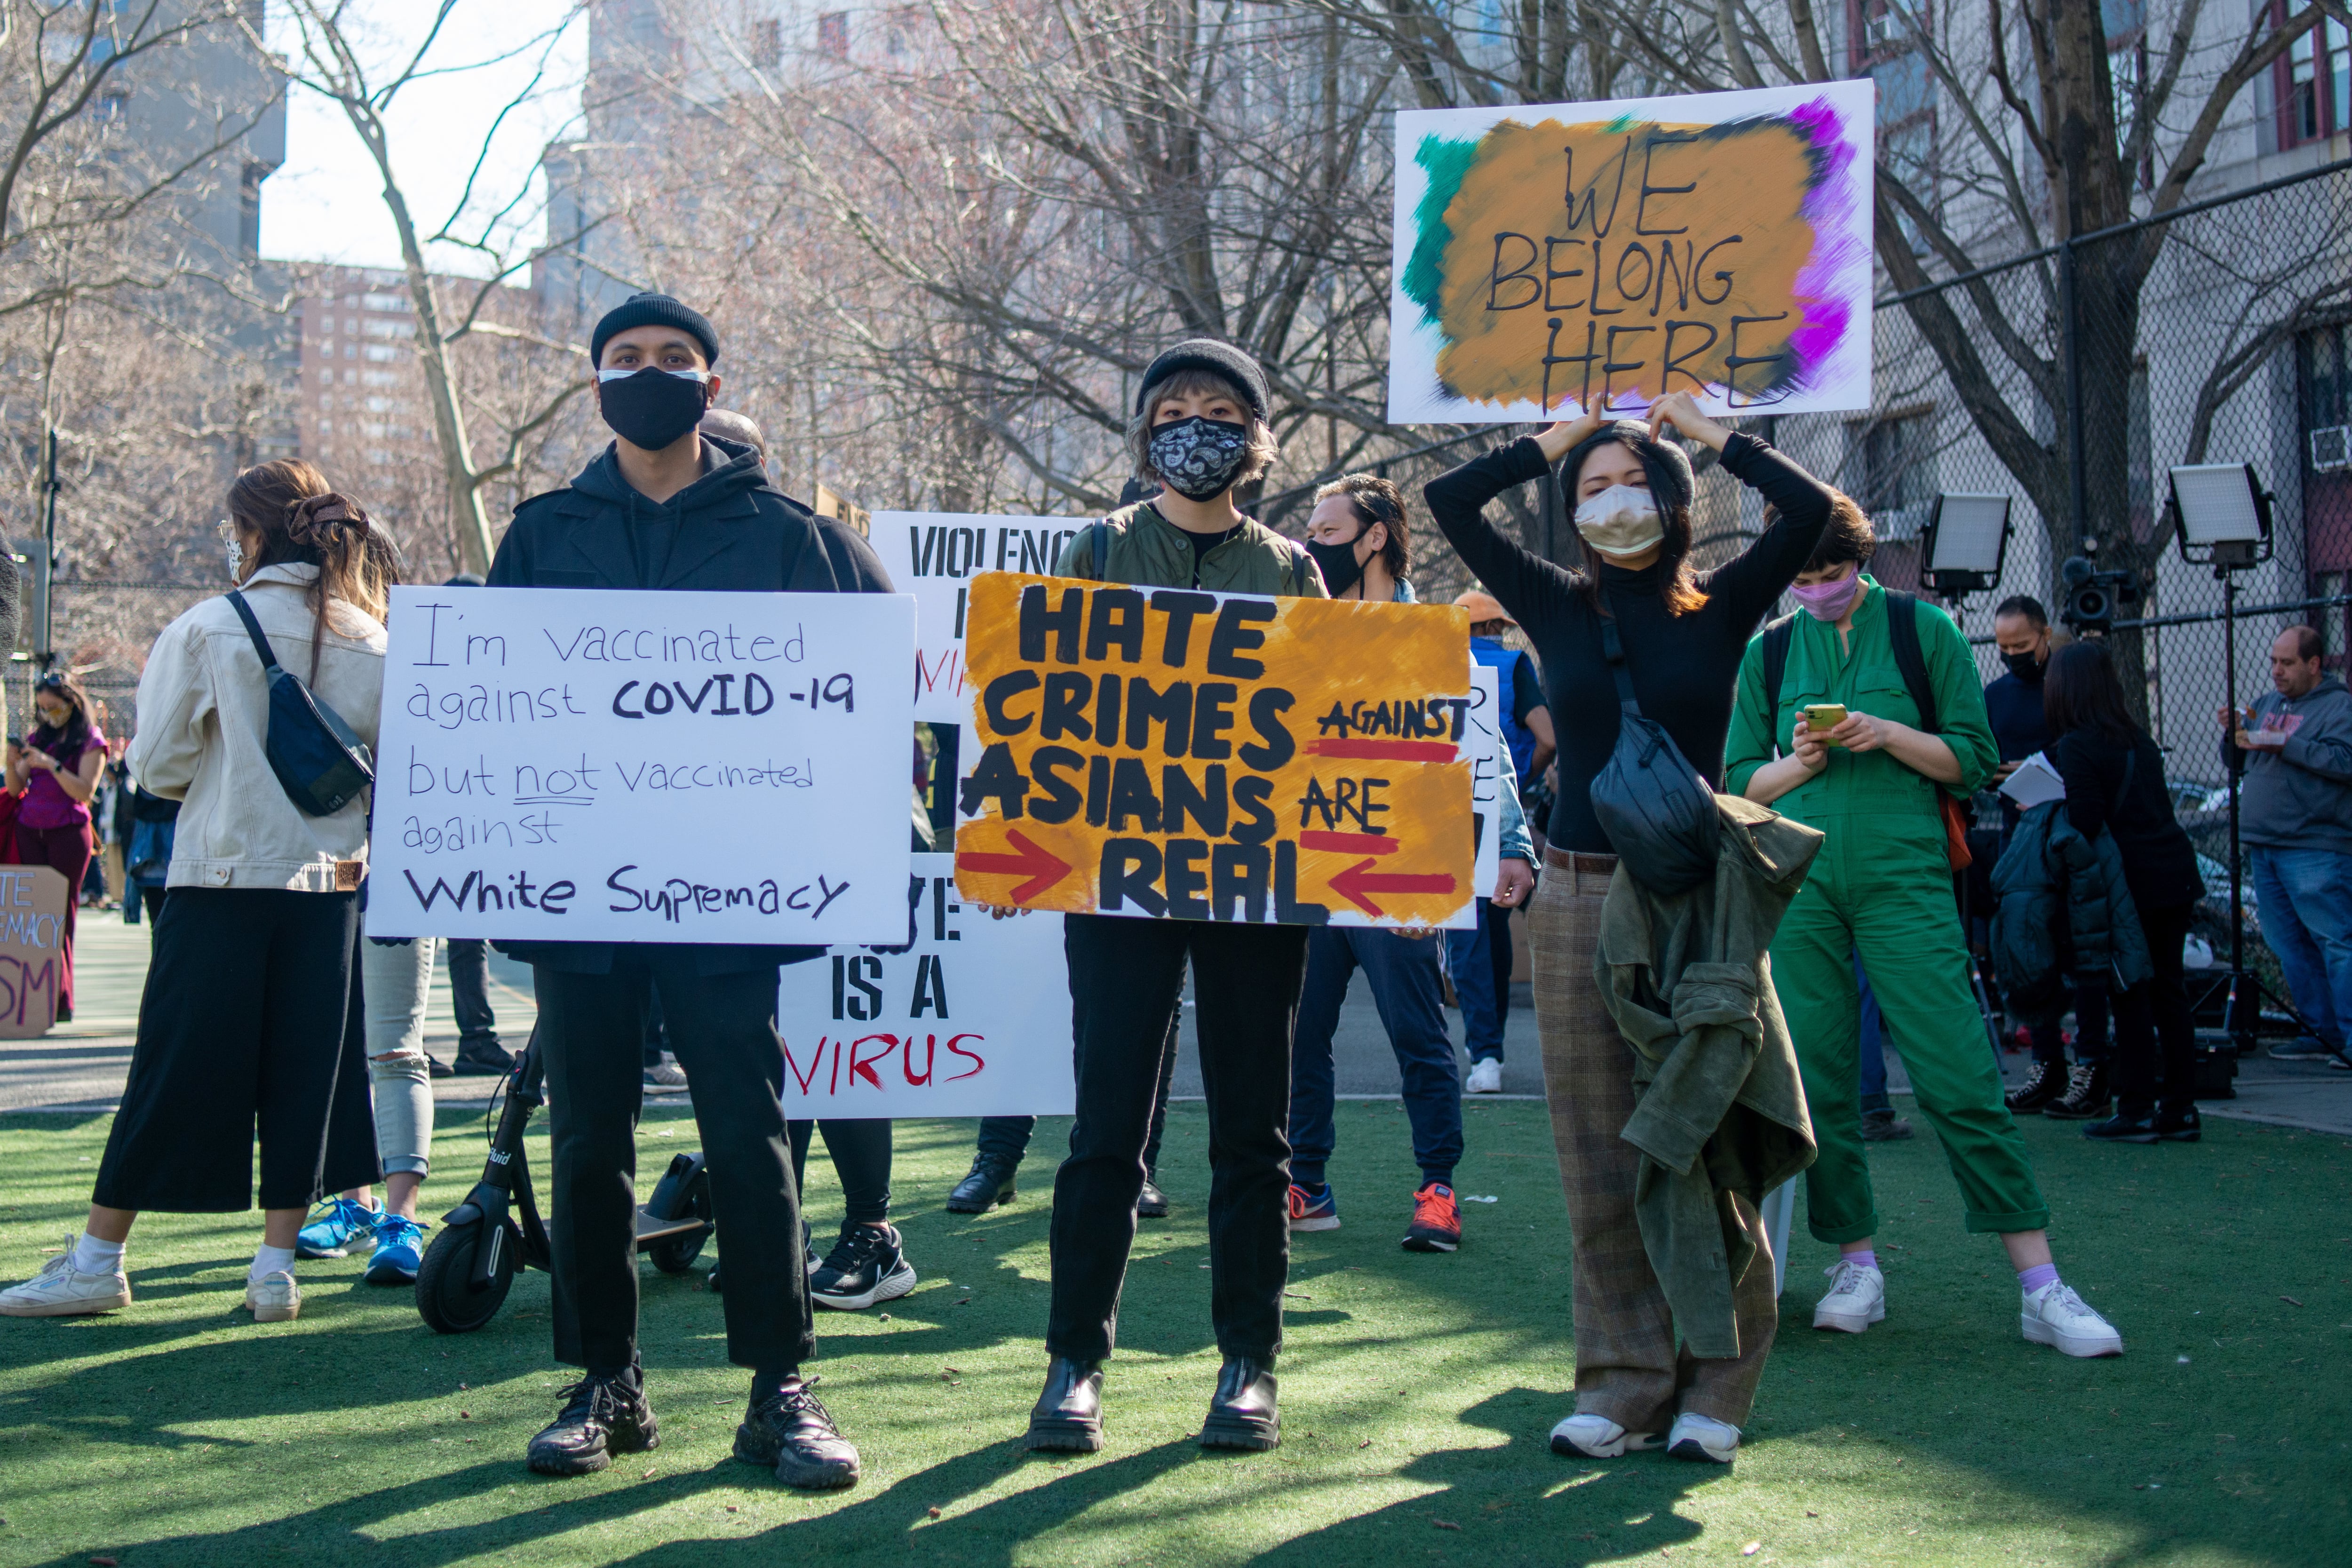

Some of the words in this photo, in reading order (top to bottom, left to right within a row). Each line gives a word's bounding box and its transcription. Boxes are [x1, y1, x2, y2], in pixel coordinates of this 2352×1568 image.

[1565, 135, 1699, 239] WE
[1485, 232, 1744, 318] BELONG
[1542, 310, 1793, 418] HERE
[413, 604, 506, 666] I'm
[1019, 584, 1278, 679] HATE
[407, 681, 587, 729] against
[983, 669, 1296, 772] CRIMES
[1318, 698, 1471, 741] AGAINST
[409, 745, 495, 797] but
[515, 753, 601, 796] not
[959, 741, 1279, 844] ASIANS
[1297, 777, 1391, 835] ARE
[403, 810, 564, 853] against
[403, 869, 577, 915] White
[607, 865, 850, 924] Supremacy
[1098, 837, 1331, 926] REAL
[832, 955, 883, 1021] IS
[910, 955, 949, 1019] A
[782, 1033, 985, 1097] VIRUS
